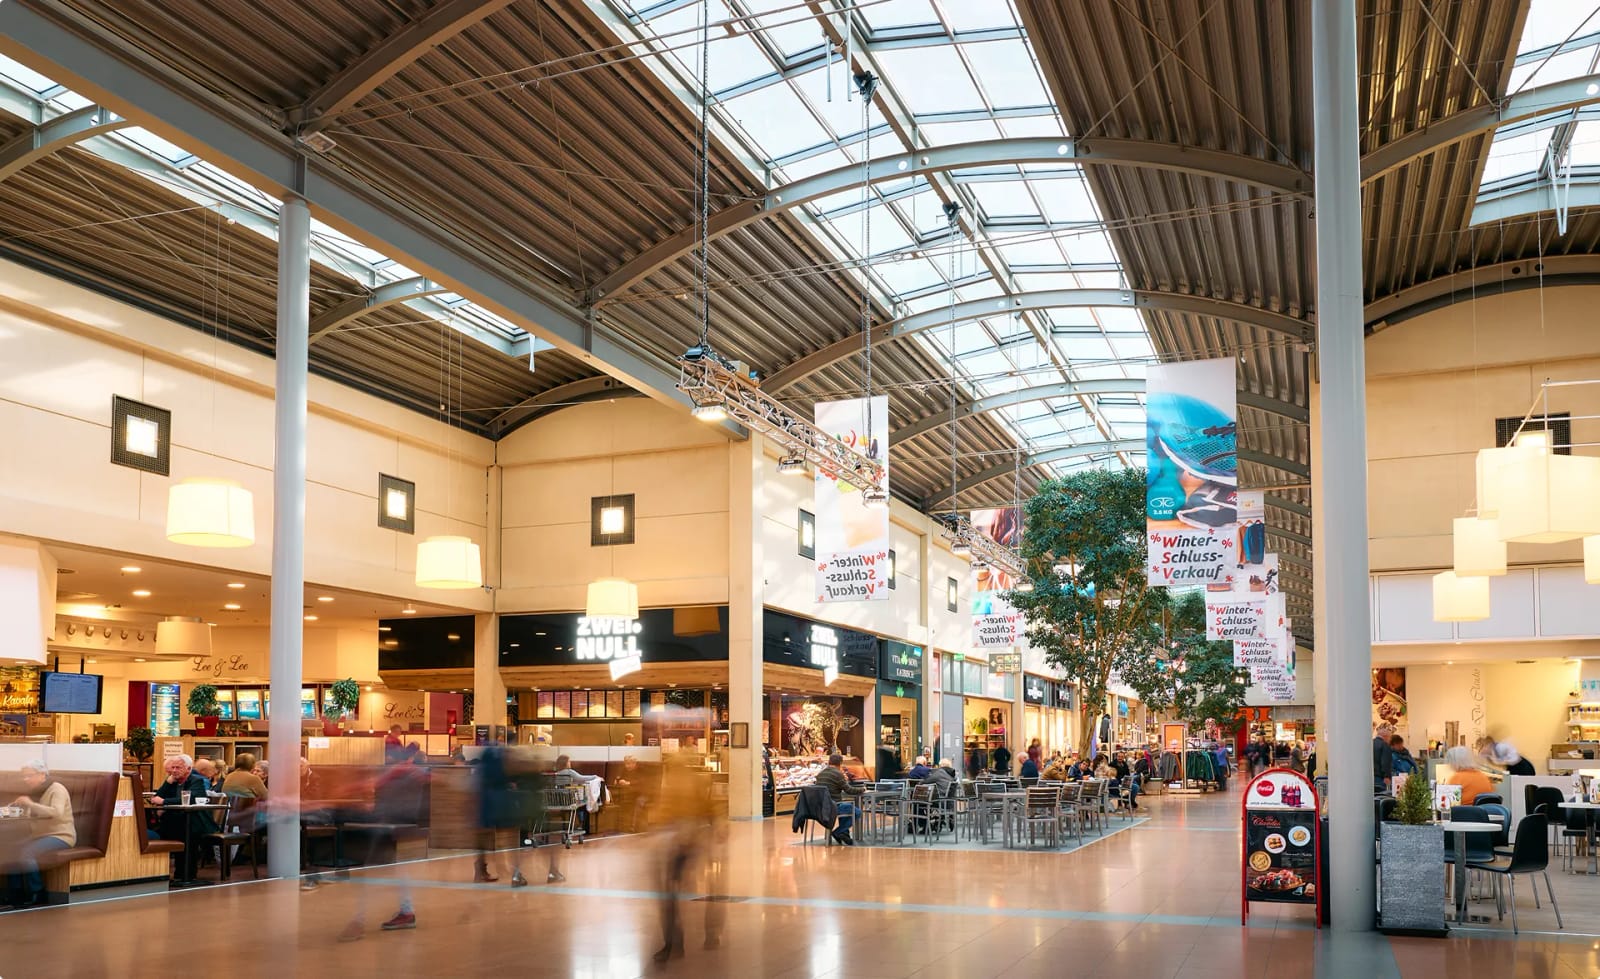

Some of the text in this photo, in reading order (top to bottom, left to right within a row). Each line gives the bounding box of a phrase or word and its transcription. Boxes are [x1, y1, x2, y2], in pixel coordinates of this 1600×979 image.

[1163, 535, 1218, 548] Winter-
[1162, 550, 1223, 564] Schluss-
[1163, 564, 1224, 580] Verkauf
[1216, 606, 1253, 615] Winter-
[1216, 616, 1256, 625] Schluss-
[1217, 626, 1257, 636] Verkauf
[577, 635, 642, 660] NULL
[1240, 648, 1272, 656] Schluss-
[192, 656, 211, 672] Lee
[228, 654, 248, 671] Lee
[1241, 656, 1272, 665] Verkauf
